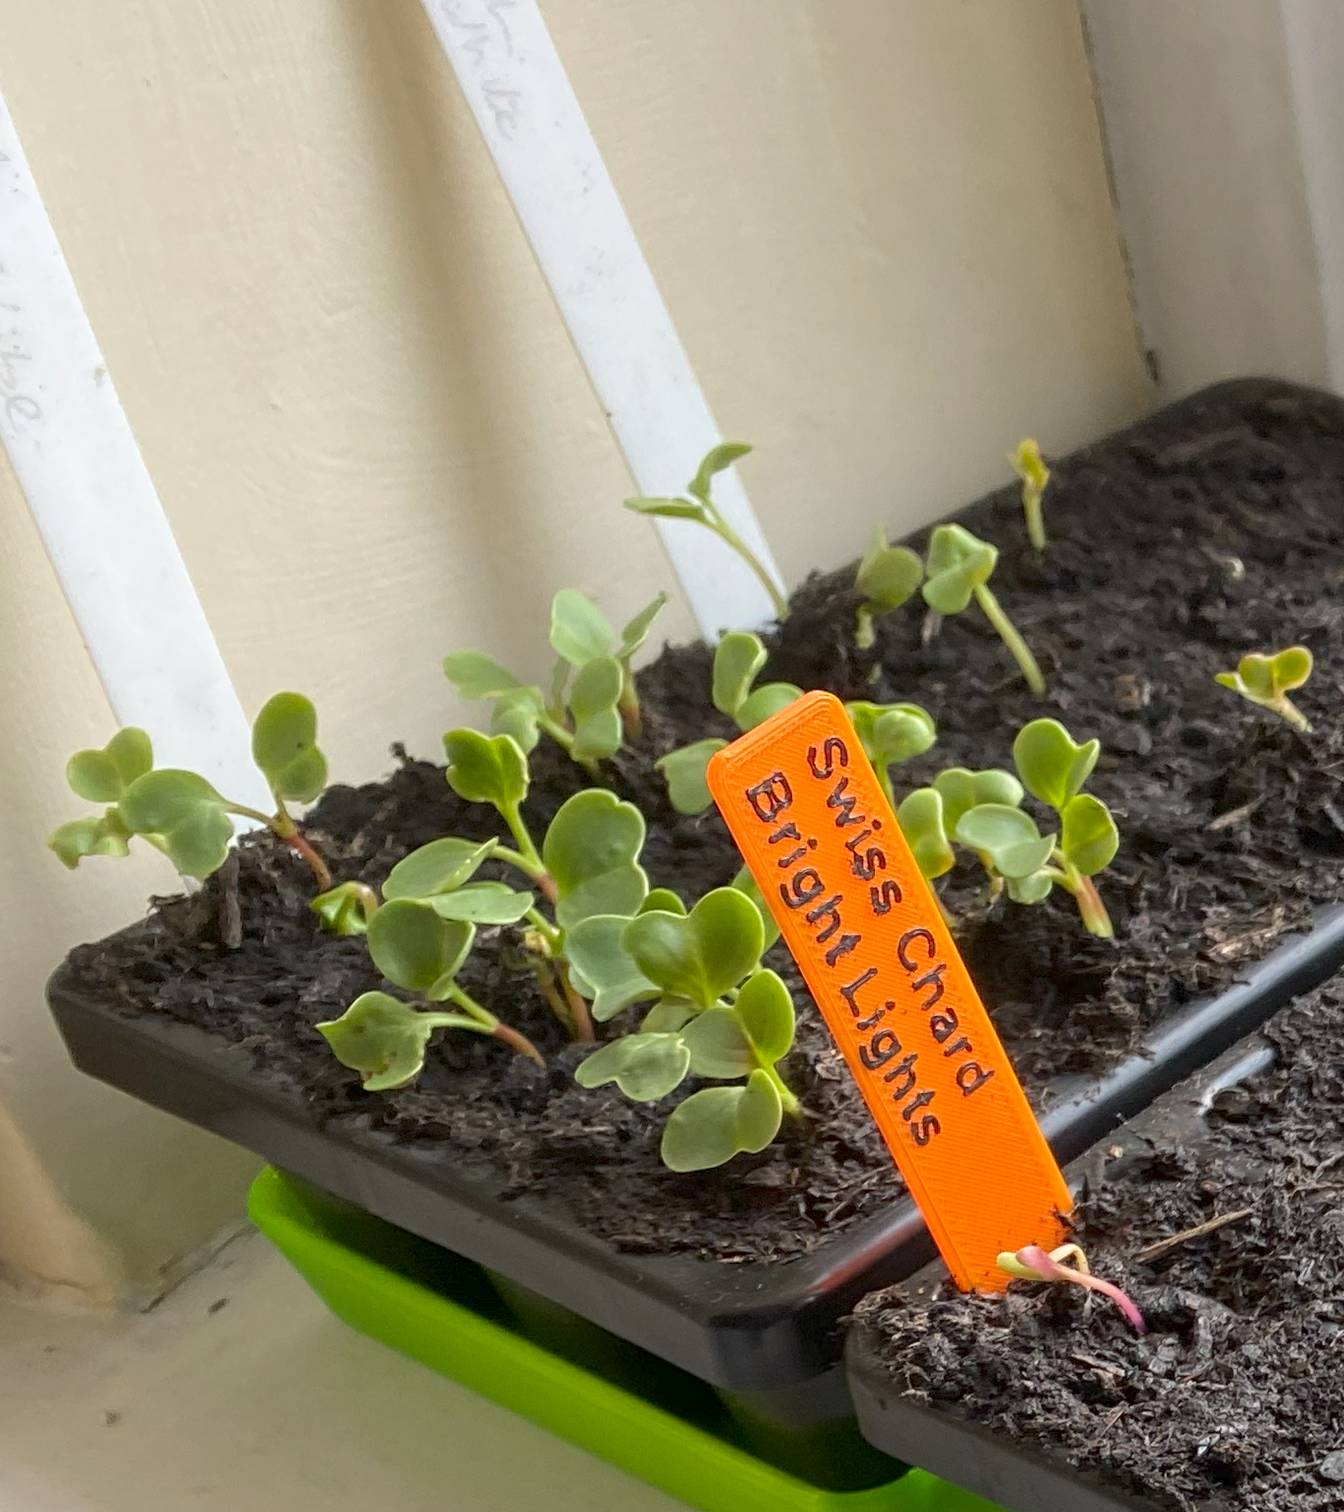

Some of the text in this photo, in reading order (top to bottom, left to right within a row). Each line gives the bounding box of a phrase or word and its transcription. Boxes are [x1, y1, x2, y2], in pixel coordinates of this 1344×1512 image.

[745, 771, 942, 1147] Bright Lights
[806, 736, 995, 1097] Swiss Chard
